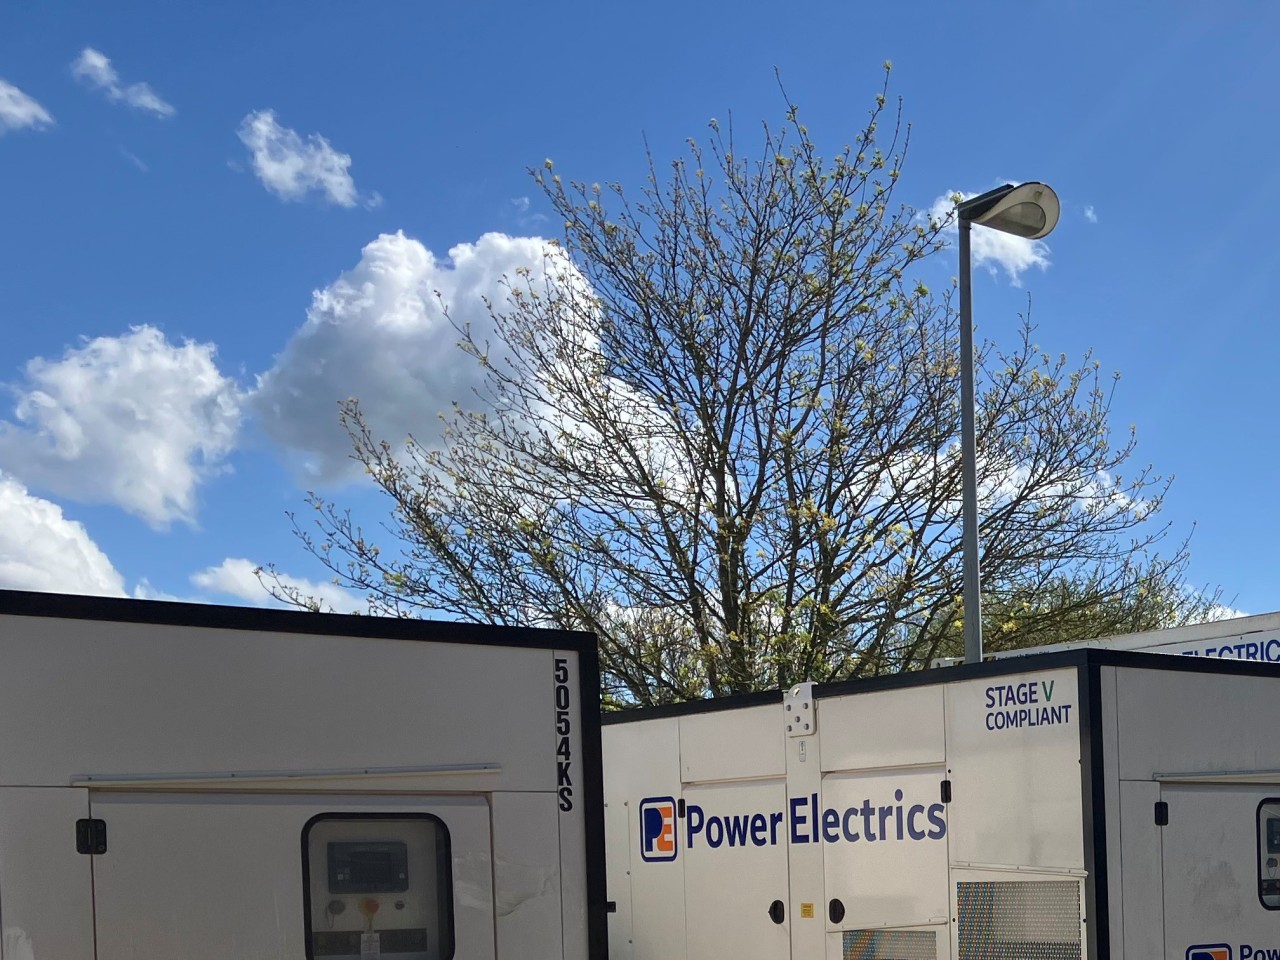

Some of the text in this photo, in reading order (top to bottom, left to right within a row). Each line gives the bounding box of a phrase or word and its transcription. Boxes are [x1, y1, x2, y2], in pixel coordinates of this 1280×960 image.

[985, 680, 1054, 709] STAGE V
[555, 659, 573, 812] 5054KS
[985, 704, 1072, 731] COMPLIANT
[686, 789, 947, 849] Power Electrics
